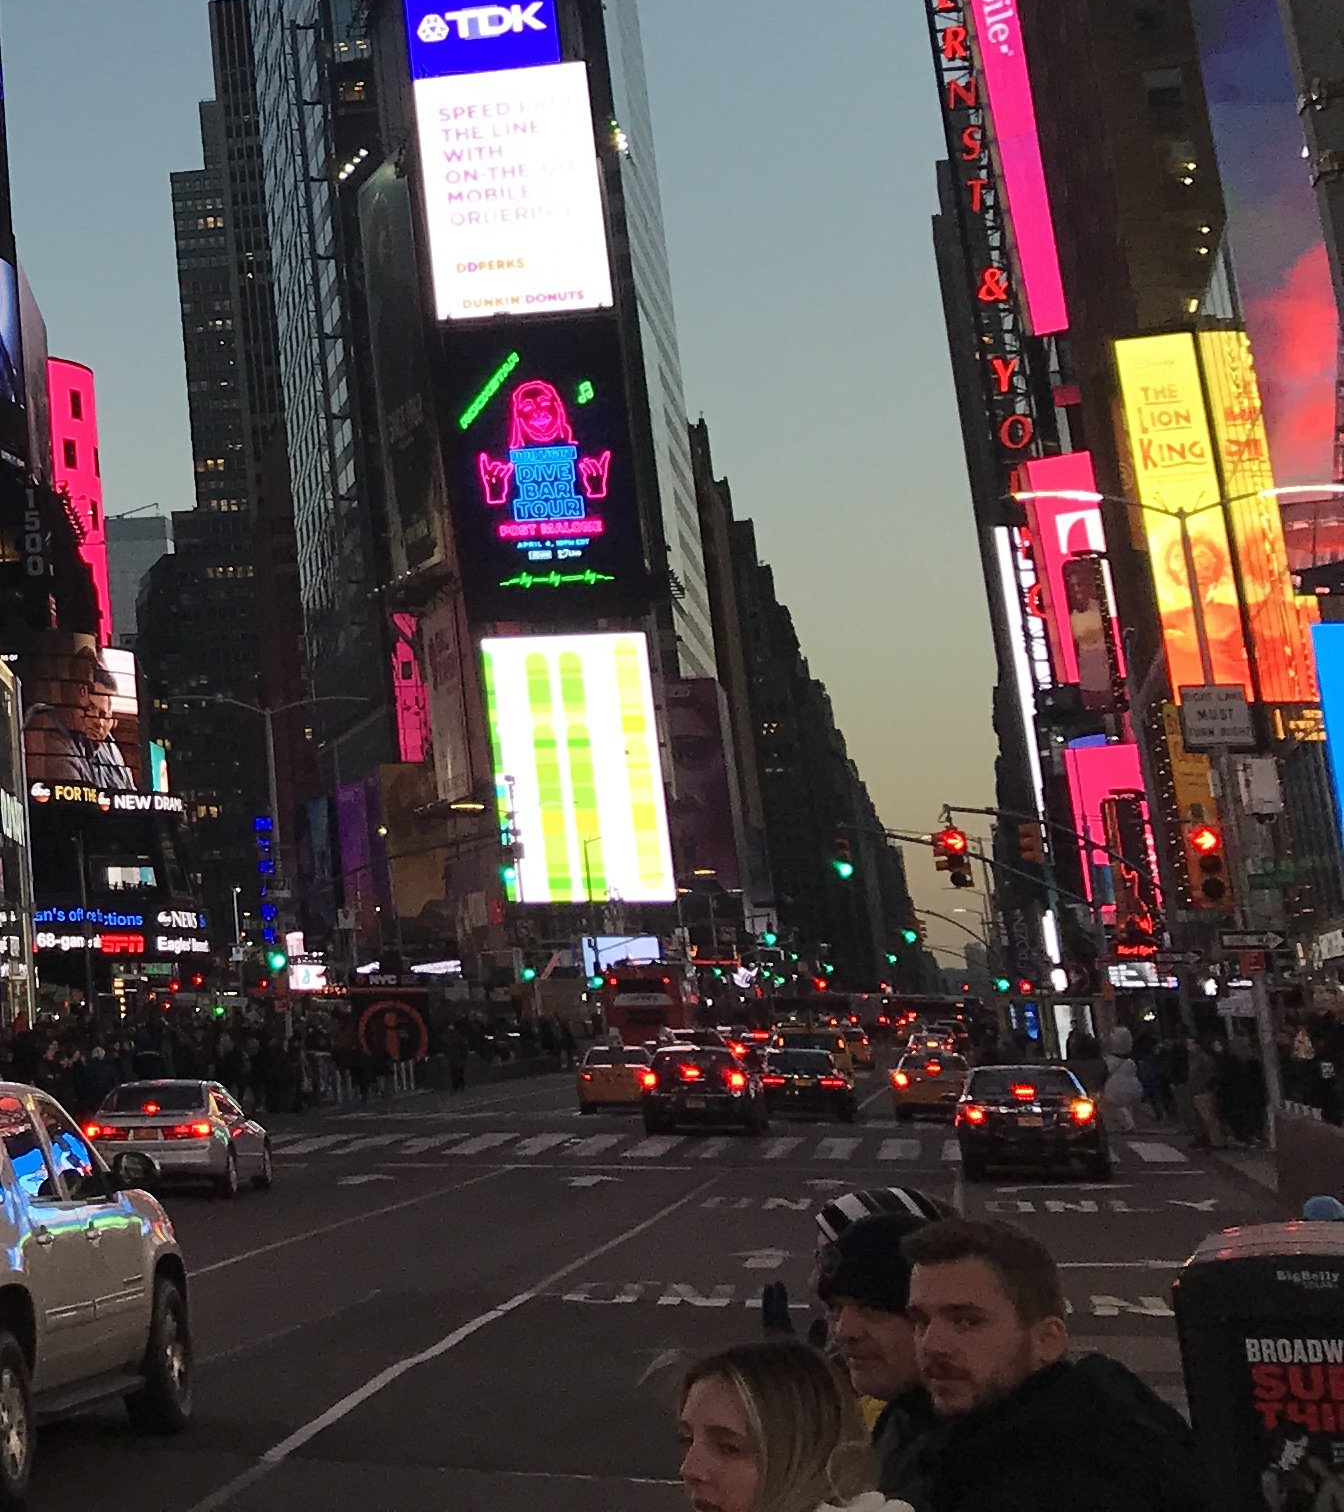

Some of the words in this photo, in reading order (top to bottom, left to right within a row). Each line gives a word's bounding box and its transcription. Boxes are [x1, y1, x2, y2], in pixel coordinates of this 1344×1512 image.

[446, 1, 547, 40] TDK
[439, 102, 510, 121] SPEED
[442, 127, 483, 142] THE
[492, 121, 539, 138] LINE
[443, 145, 503, 163] WITH
[448, 186, 533, 204] MOBILE
[525, 290, 584, 304] DONUTS
[1139, 385, 1181, 403] THE
[1138, 406, 1192, 435] LION
[1139, 438, 1206, 470] KING
[520, 464, 571, 482] DIVE
[525, 482, 570, 500] BAR
[518, 499, 580, 518] TOUR
[499, 524, 537, 536] POST
[540, 520, 602, 535] MALONE
[54, 785, 81, 801] FOR
[114, 794, 152, 810] NEW
[171, 910, 197, 929] NEWS
